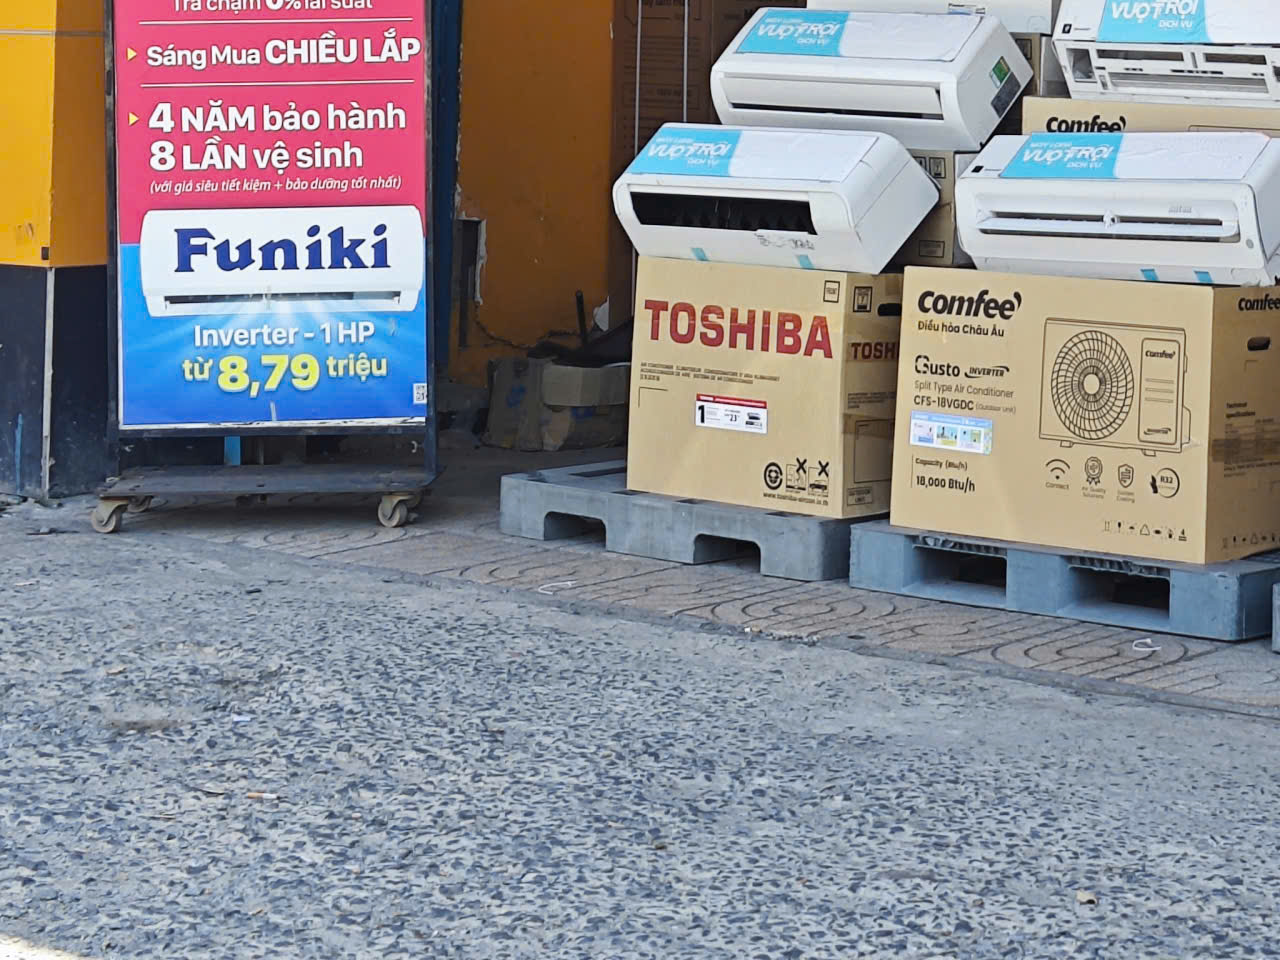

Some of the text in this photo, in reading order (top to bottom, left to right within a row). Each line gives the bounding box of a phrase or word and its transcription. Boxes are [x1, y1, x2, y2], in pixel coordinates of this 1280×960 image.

[147, 28, 421, 70] Sáng Mua CHIỀU LẮP
[149, 99, 406, 133] 4 NĂM bảo hành
[150, 135, 363, 175] 8 LẦN vệ sinh
[195, 179, 218, 192] siêu
[221, 178, 241, 192] tiết
[243, 178, 271, 193] kiệm
[274, 181, 283, 190] +
[286, 178, 308, 191] bảo
[310, 177, 348, 193] dưỡng
[351, 178, 367, 190] tốt
[369, 176, 402, 192] nhất)
[174, 223, 391, 273] Funiki
[195, 324, 299, 347] Inverter
[644, 299, 833, 359] TOSHIBA
[962, 324, 989, 336] Châu
[991, 323, 1005, 337] Âu
[851, 342, 896, 360] TOSH
[183, 354, 387, 399] từ 8,79 triệu
[915, 354, 1006, 377] Gusto INVERTER
[915, 380, 1014, 398] Split Type Air Conditioner
[914, 395, 974, 410] CFS-18VGDC
[698, 405, 706, 424] 1
[916, 475, 976, 493] 18,000 Btu/h
